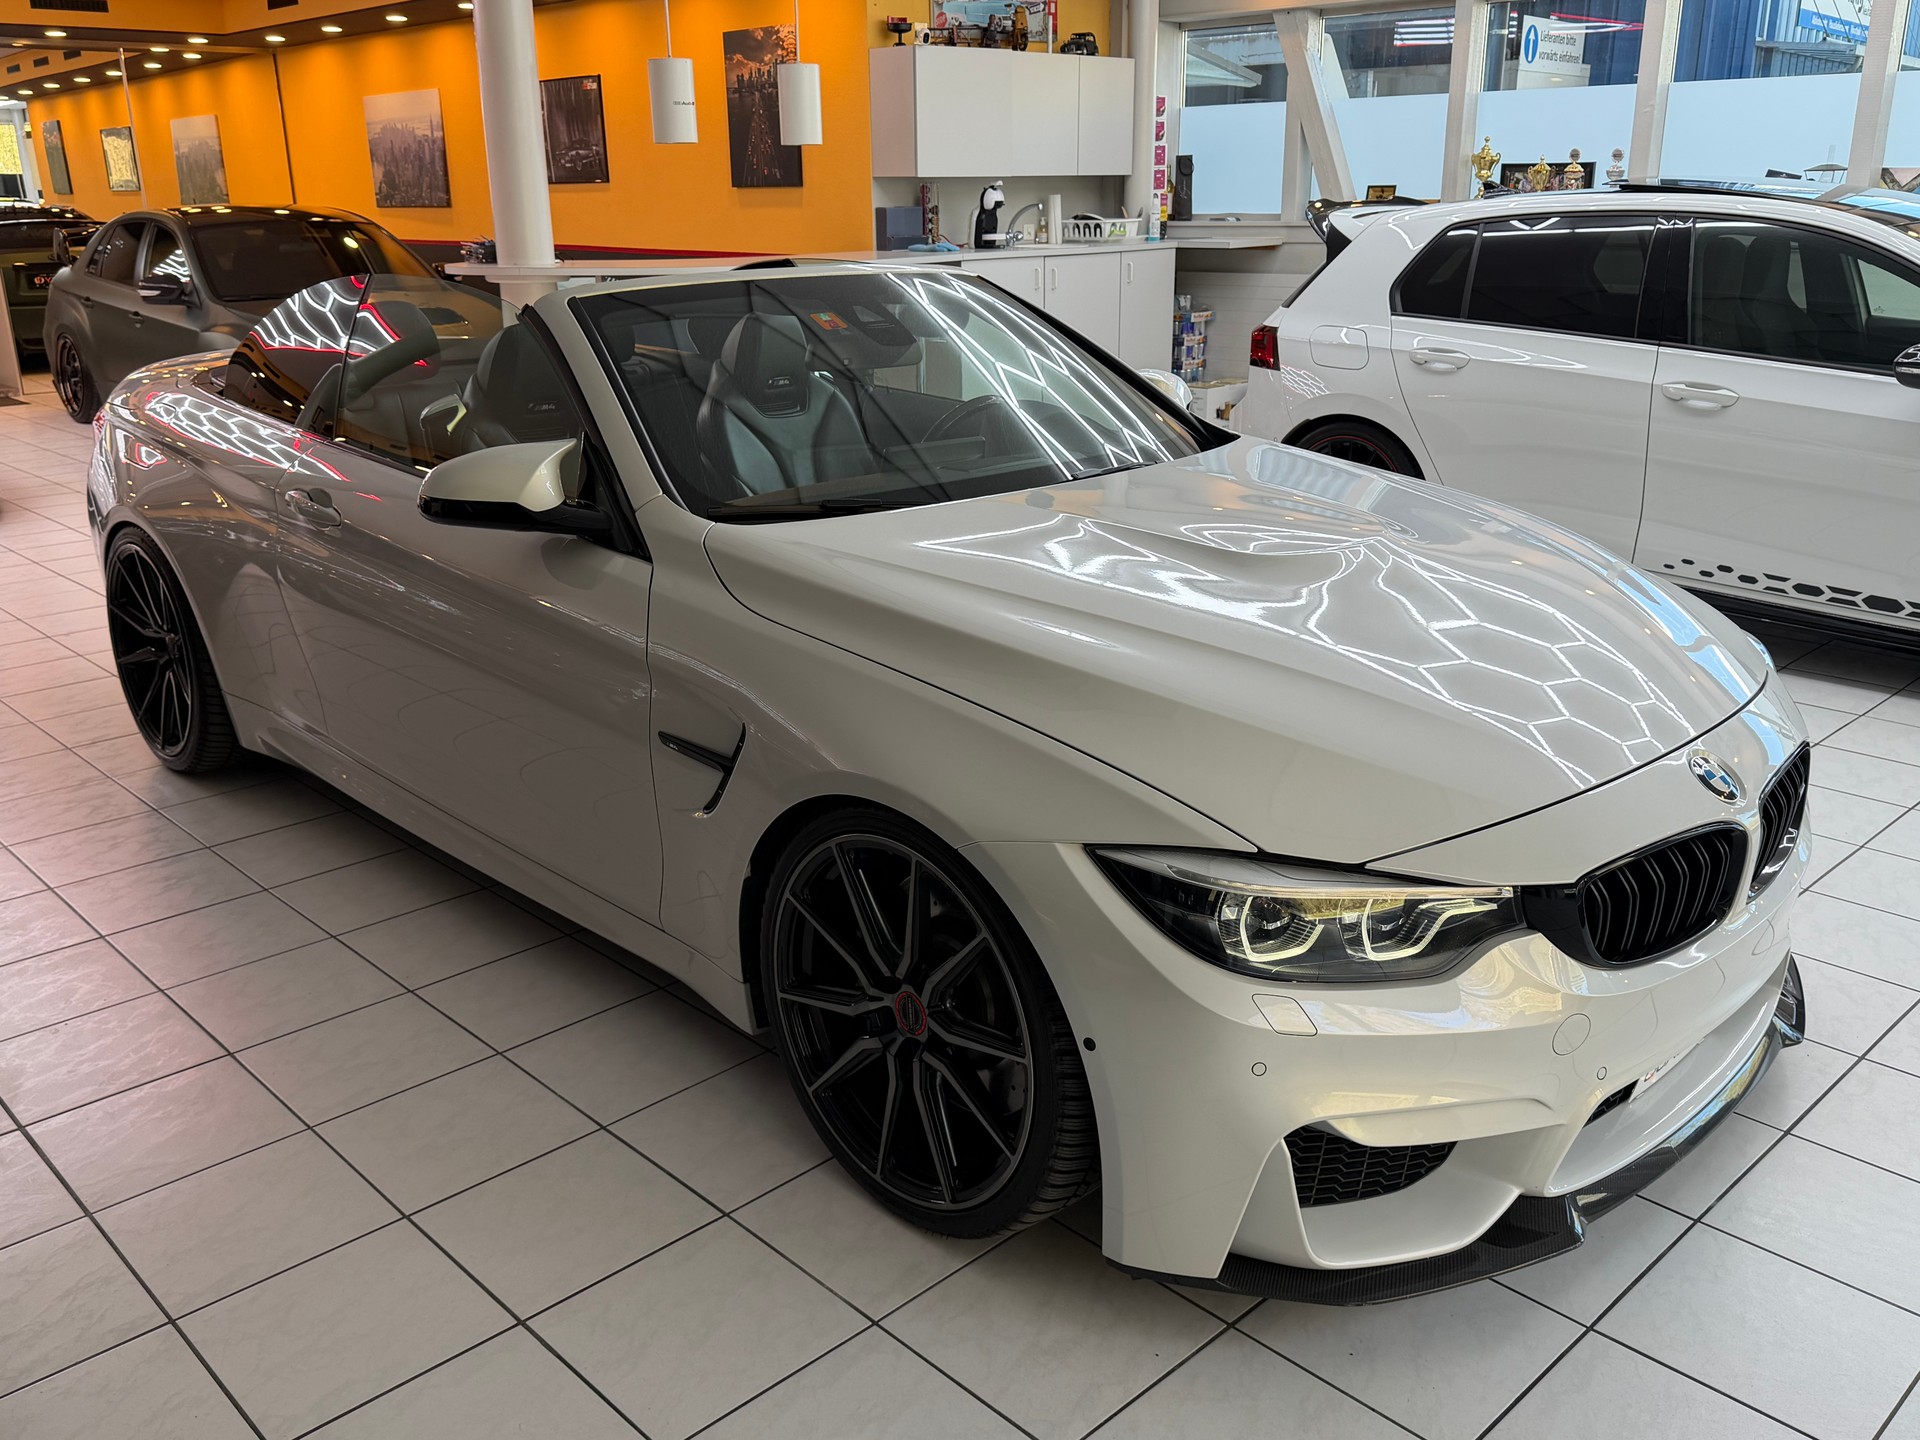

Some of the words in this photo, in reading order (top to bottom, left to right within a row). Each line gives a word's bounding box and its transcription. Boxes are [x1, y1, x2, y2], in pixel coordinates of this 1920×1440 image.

[1540, 30, 1566, 44] Lieferanten
[1566, 33, 1577, 46] bitte
[1538, 49, 1559, 62] vorwärts
[1559, 51, 1581, 64] einfahren!
